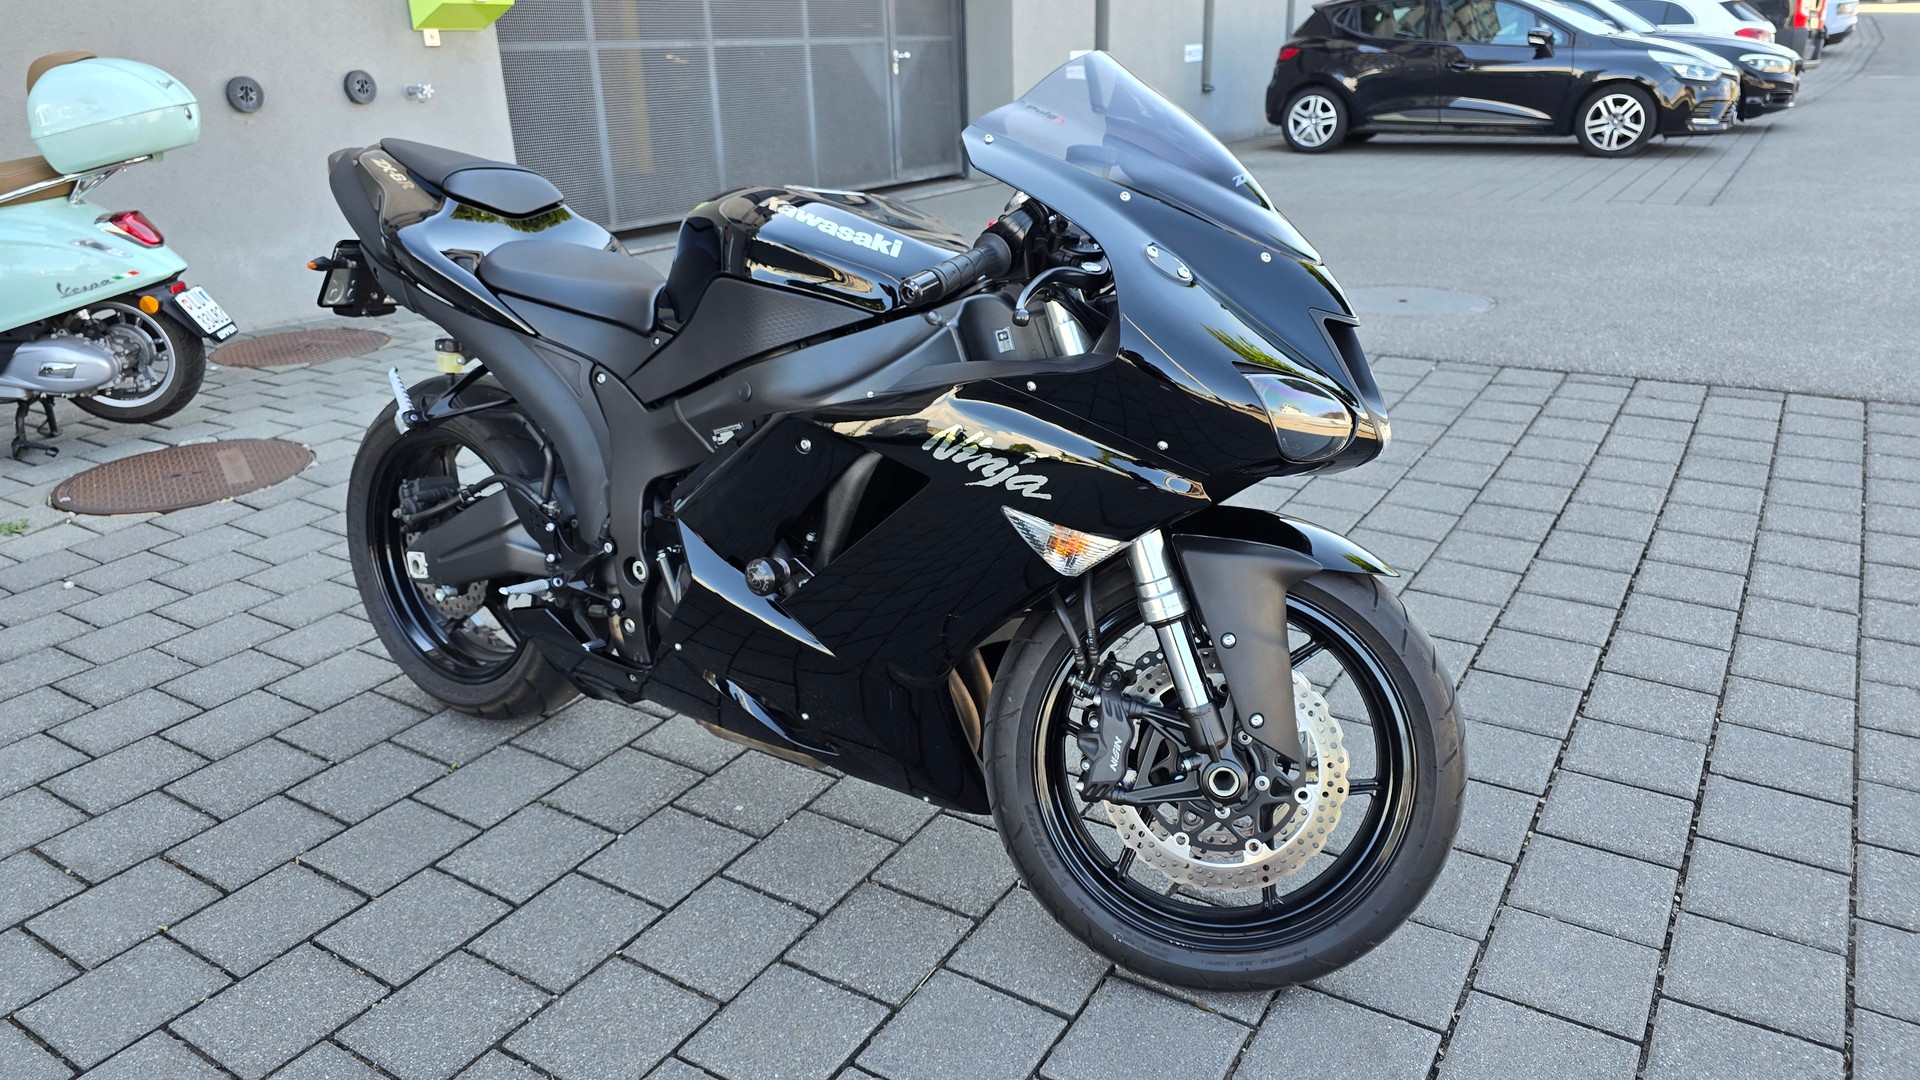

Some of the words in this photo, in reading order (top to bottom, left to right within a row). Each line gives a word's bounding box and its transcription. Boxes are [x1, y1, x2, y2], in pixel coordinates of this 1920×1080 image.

[758, 196, 904, 258] Kawasaki
[56, 279, 116, 299] Vespa
[921, 423, 1053, 501] Ninja
